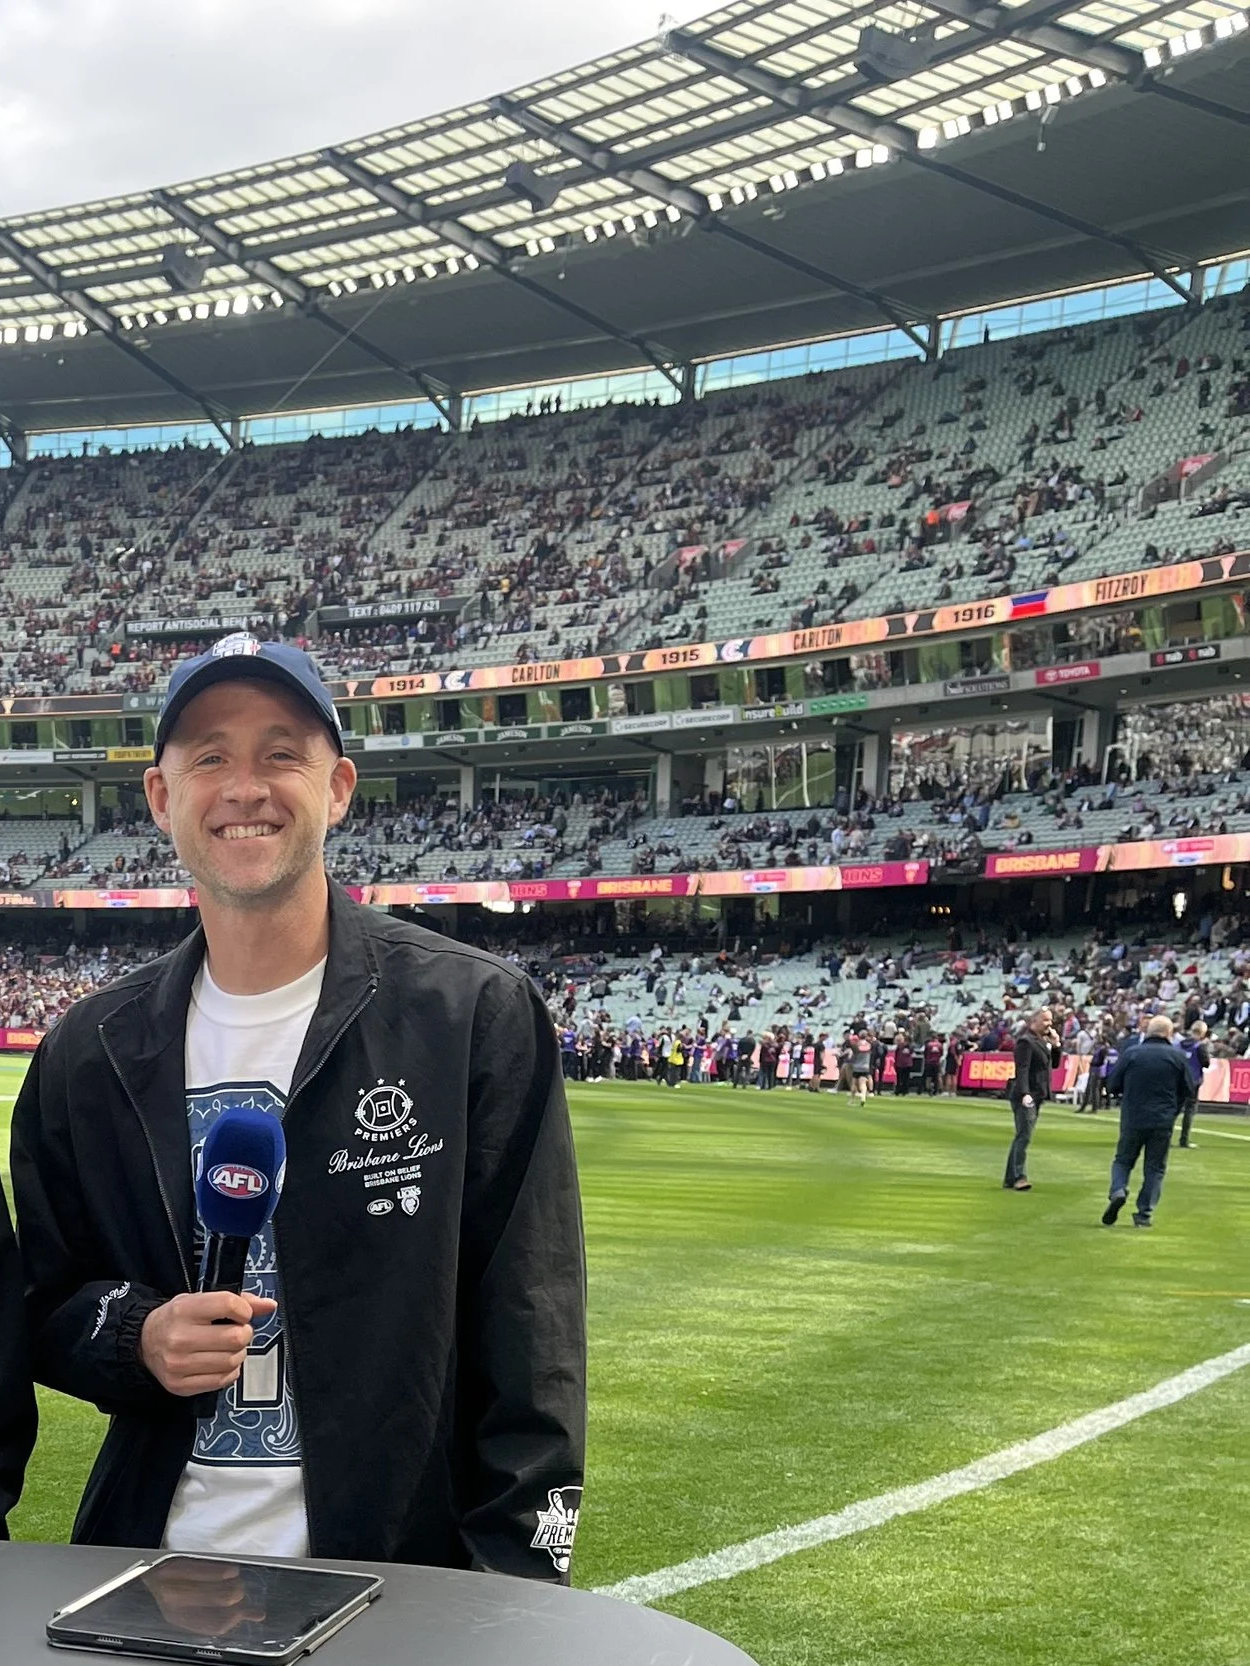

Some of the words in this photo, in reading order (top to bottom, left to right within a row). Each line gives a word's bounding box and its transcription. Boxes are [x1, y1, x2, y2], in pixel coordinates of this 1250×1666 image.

[953, 604, 995, 623] 1916
[1096, 574, 1148, 601] FITZROY
[403, 601, 420, 614] 117
[127, 618, 162, 634] REPORT
[164, 616, 220, 631] ANTISOCIAL
[661, 649, 700, 664] 1915
[793, 628, 841, 651] CARLTON
[389, 678, 425, 691] 1914
[512, 664, 560, 683] CARLTON
[1057, 666, 1089, 679] TOYOTA
[497, 730, 529, 741] JAMESON
[560, 725, 593, 736] JAMESON
[436, 733, 466, 746] JAMESON
[995, 853, 1081, 873] BRISBANE
[597, 879, 673, 894] BRISBANE
[354, 1117, 418, 1141] PREMIERS
[328, 1148, 400, 1174] Brisbane
[403, 1133, 444, 1160] Lions
[213, 1170, 262, 1192] AFL
[364, 1171, 383, 1181] BUILT
[384, 1170, 396, 1178] ON
[397, 1164, 421, 1175] BELIEF
[364, 1176, 399, 1188] BRISBANE
[400, 1172, 422, 1181] LIONS
[370, 1200, 391, 1212] AFL
